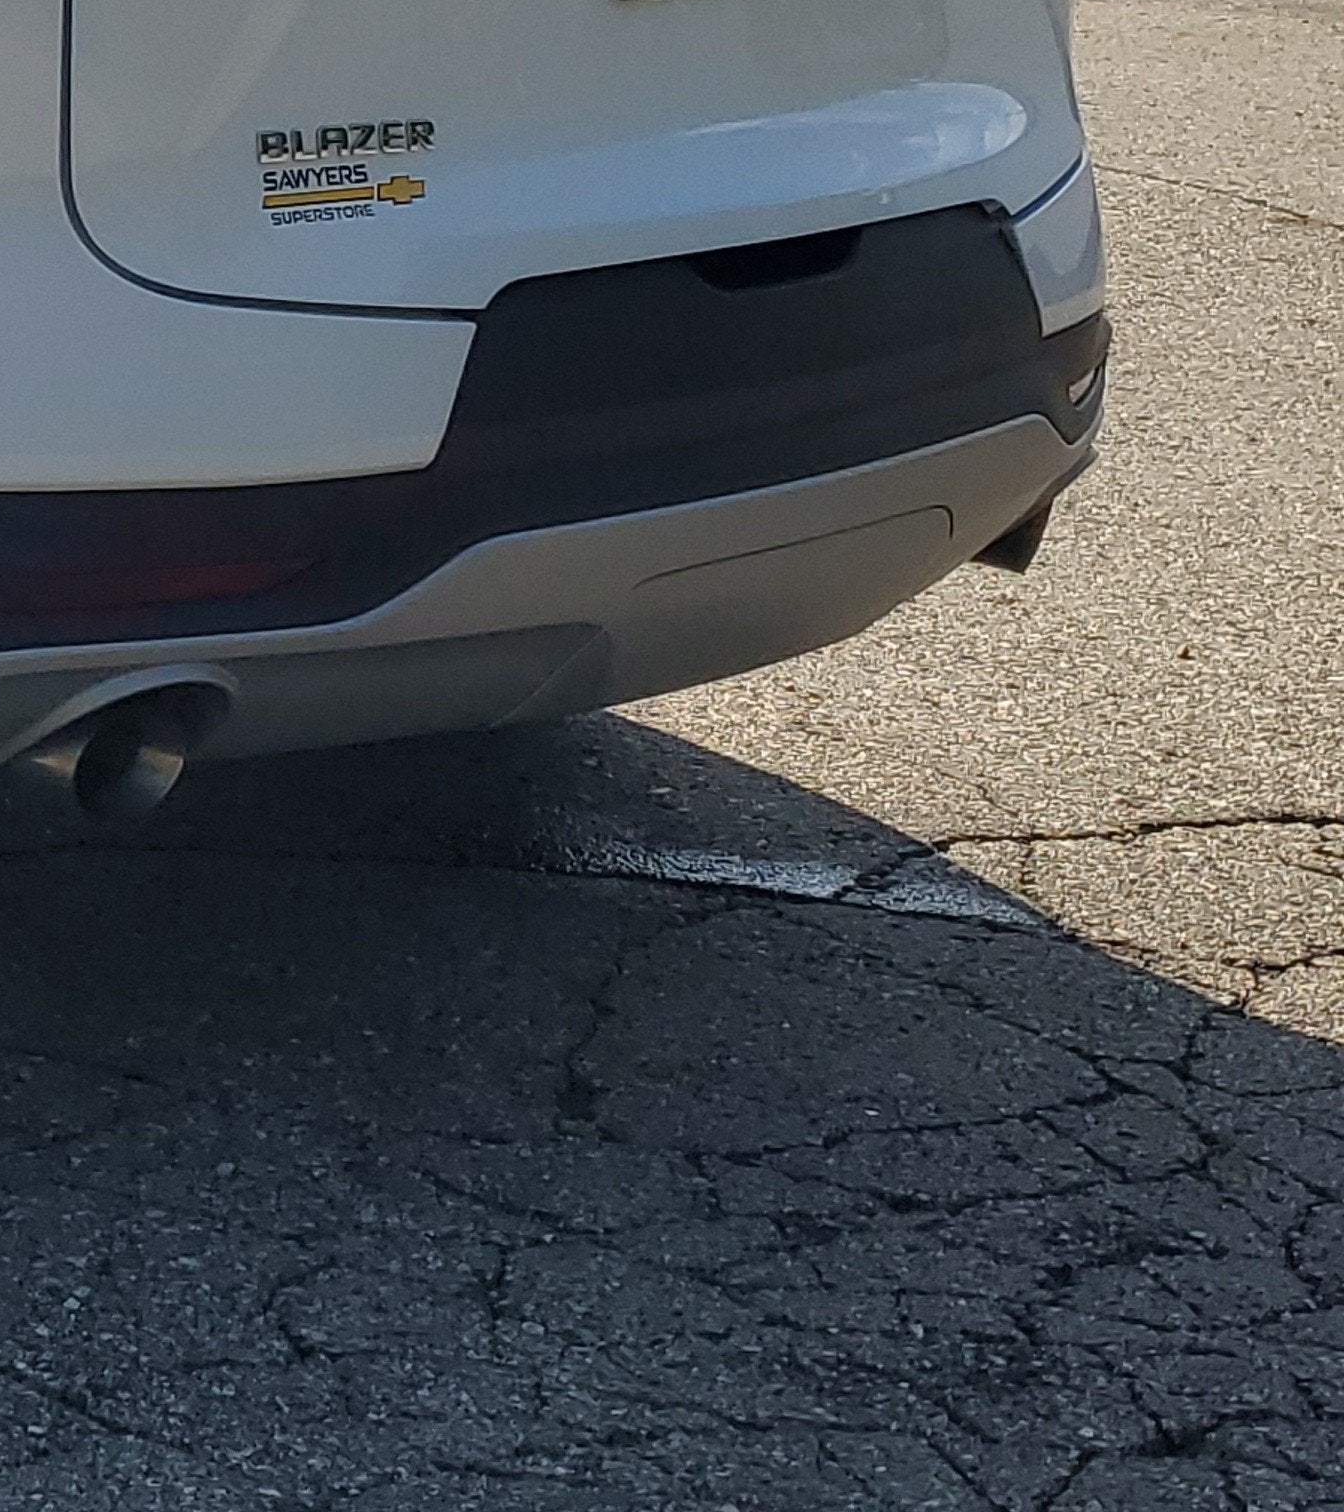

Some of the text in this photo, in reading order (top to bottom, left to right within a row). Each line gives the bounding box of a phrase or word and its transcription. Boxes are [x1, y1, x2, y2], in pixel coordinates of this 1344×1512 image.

[257, 118, 436, 164] BLAZER
[262, 163, 368, 192] SAWYERS
[270, 203, 375, 226] SUPERSTORE
